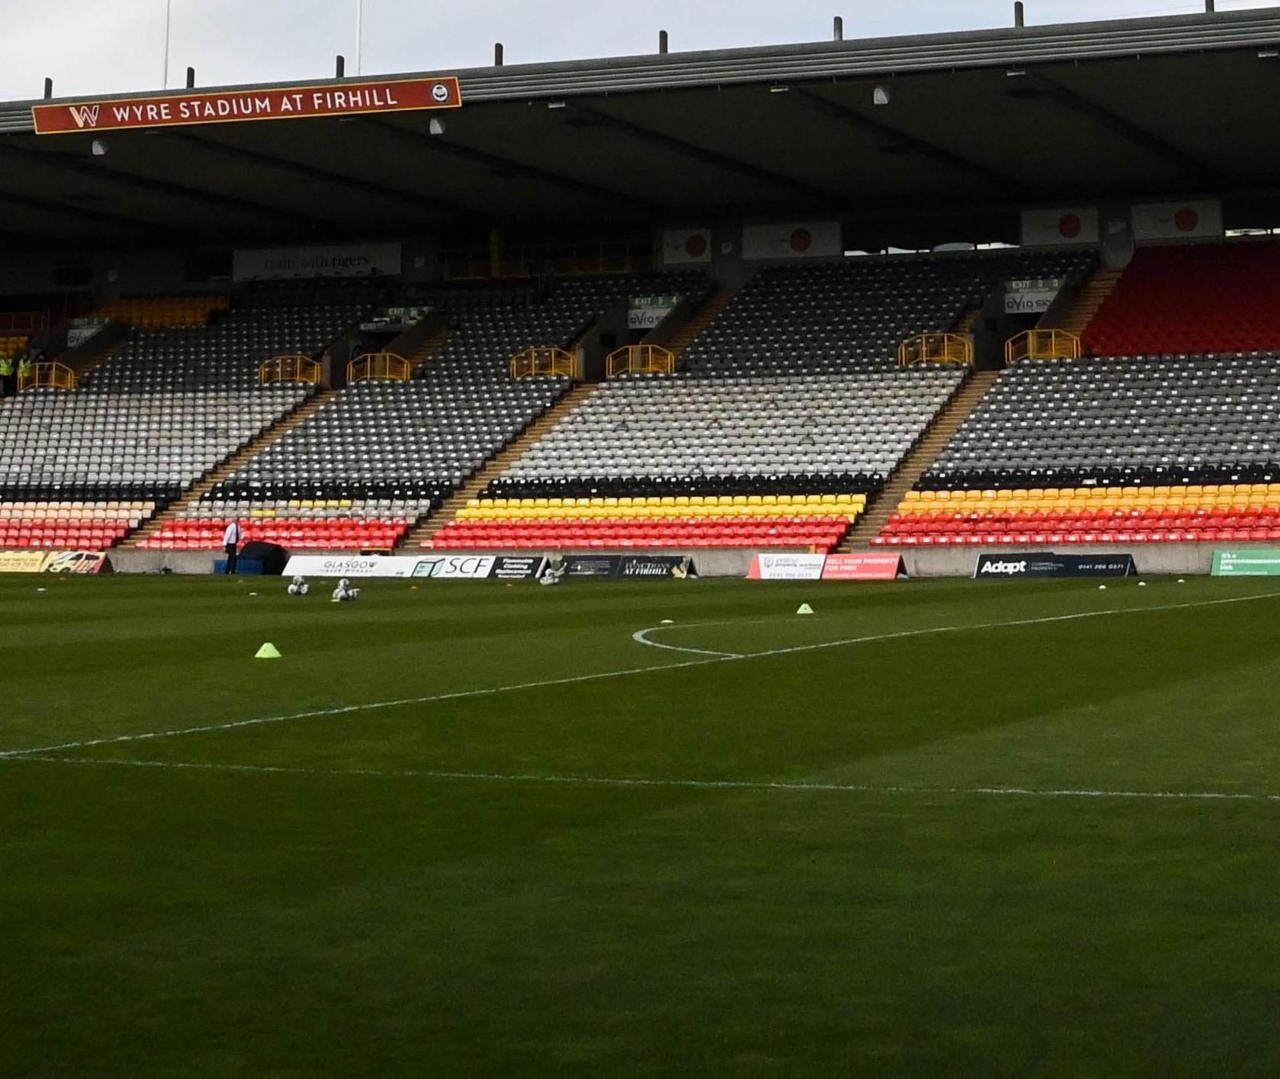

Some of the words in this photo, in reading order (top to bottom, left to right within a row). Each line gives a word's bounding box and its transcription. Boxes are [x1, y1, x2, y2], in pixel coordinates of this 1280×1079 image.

[112, 104, 172, 123] WYRE
[180, 97, 271, 118] STADIUM
[280, 94, 305, 111] AT
[314, 88, 398, 110] FIRHILL
[324, 561, 377, 569] GLASGOW
[445, 557, 490, 574] SCF
[980, 560, 1028, 574] Adapt
